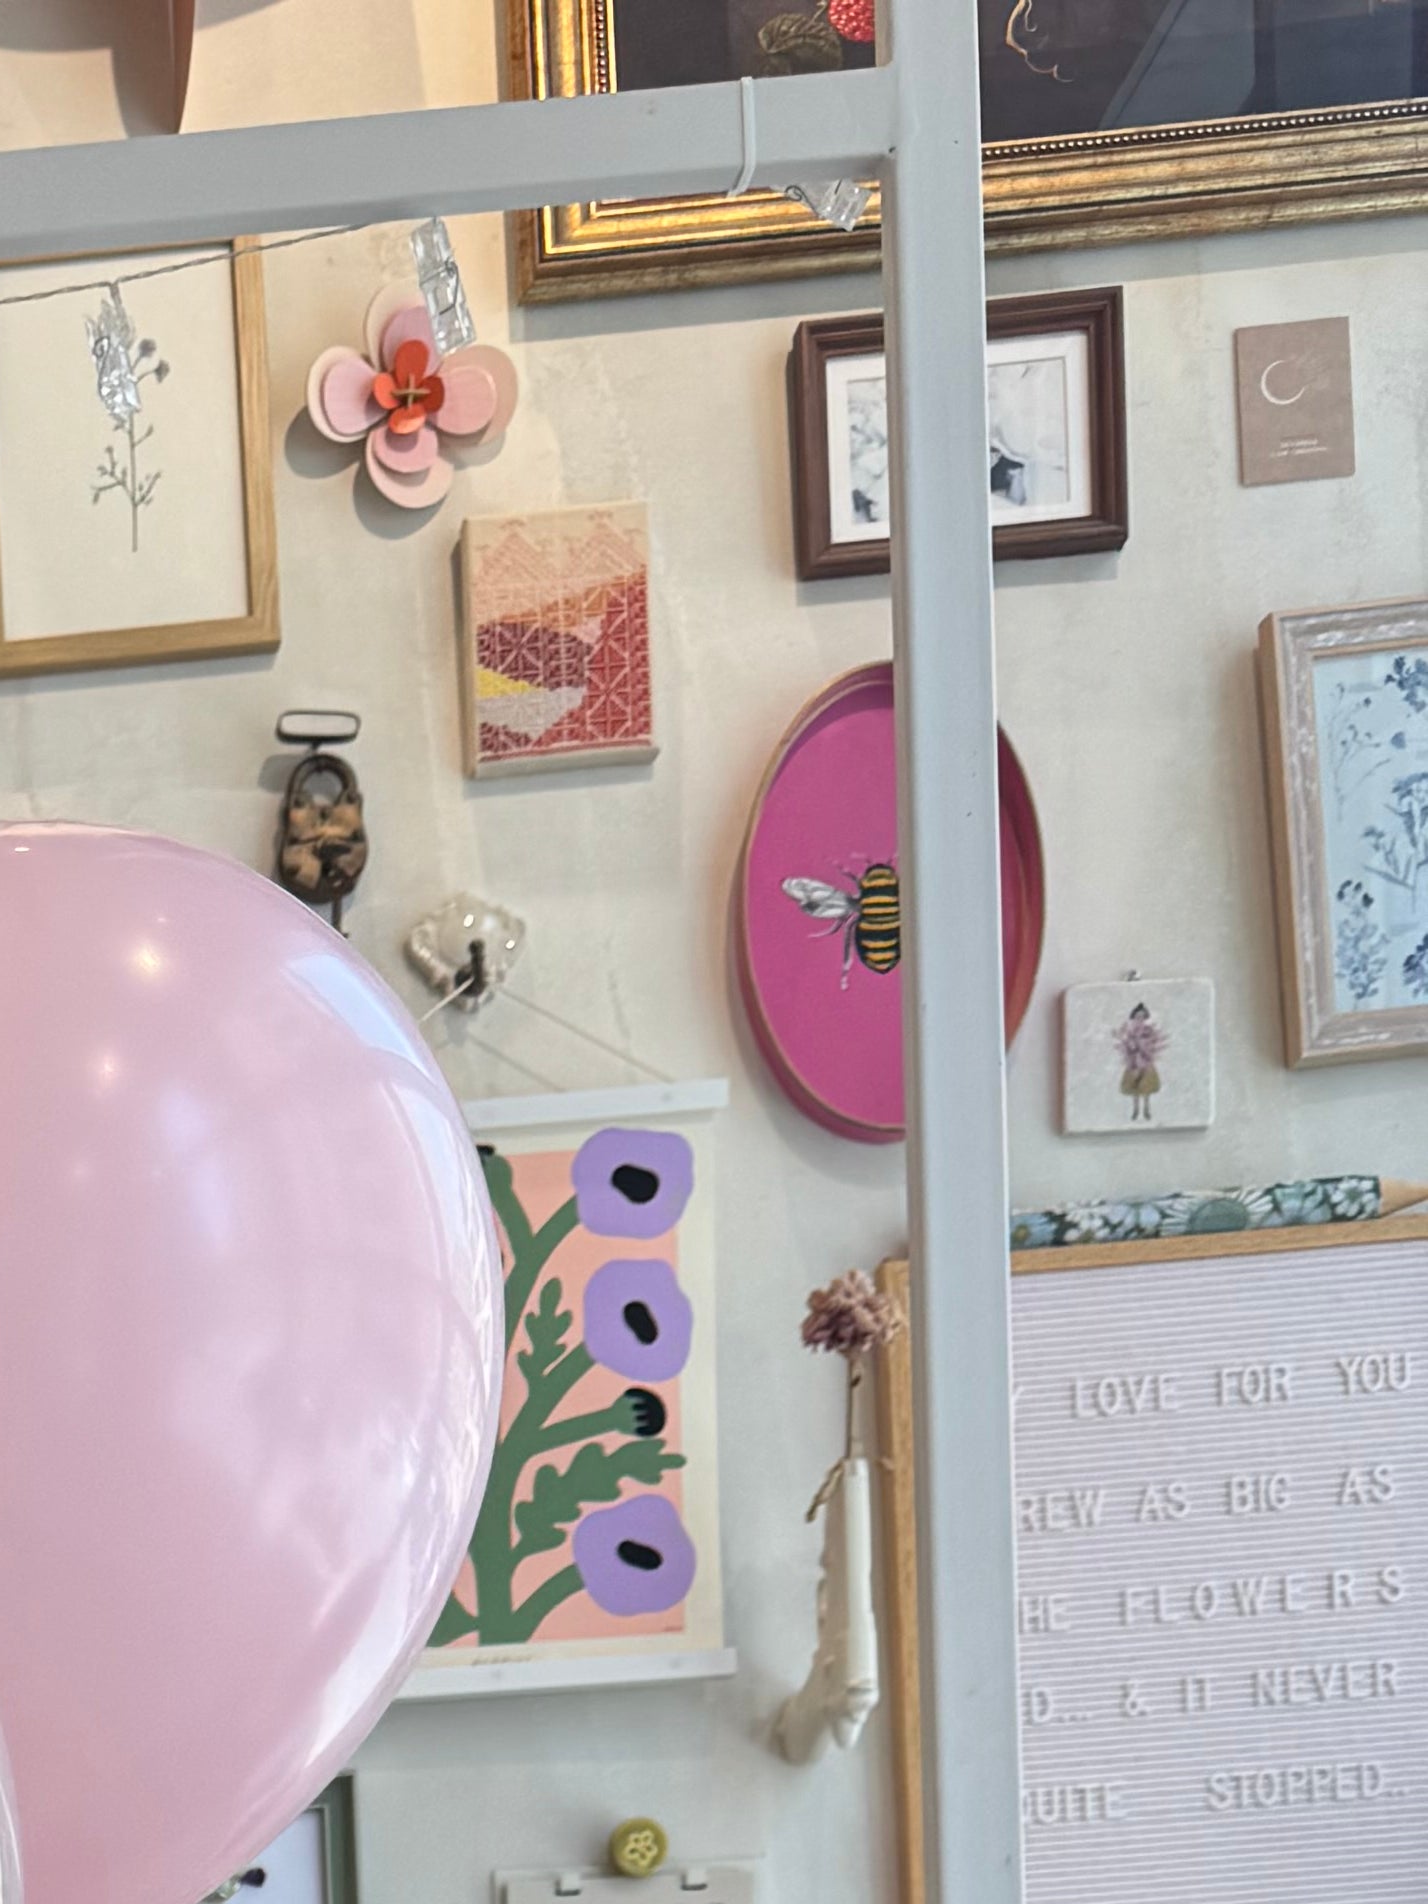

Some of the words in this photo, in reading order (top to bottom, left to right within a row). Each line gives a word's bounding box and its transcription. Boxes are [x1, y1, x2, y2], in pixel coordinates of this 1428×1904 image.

[1070, 1372, 1181, 1420] LOVE
[1217, 1362, 1293, 1409] FOR
[1336, 1350, 1412, 1397] YOU
[1017, 1487, 1105, 1535] REW
[1137, 1479, 1194, 1525] AS
[1225, 1471, 1293, 1518] BIG
[1336, 1462, 1398, 1508] AS
[1018, 1592, 1073, 1636] HE
[1119, 1564, 1406, 1629] FLOWERS
[1118, 1678, 1150, 1720] &
[1248, 1657, 1400, 1709] NEVER
